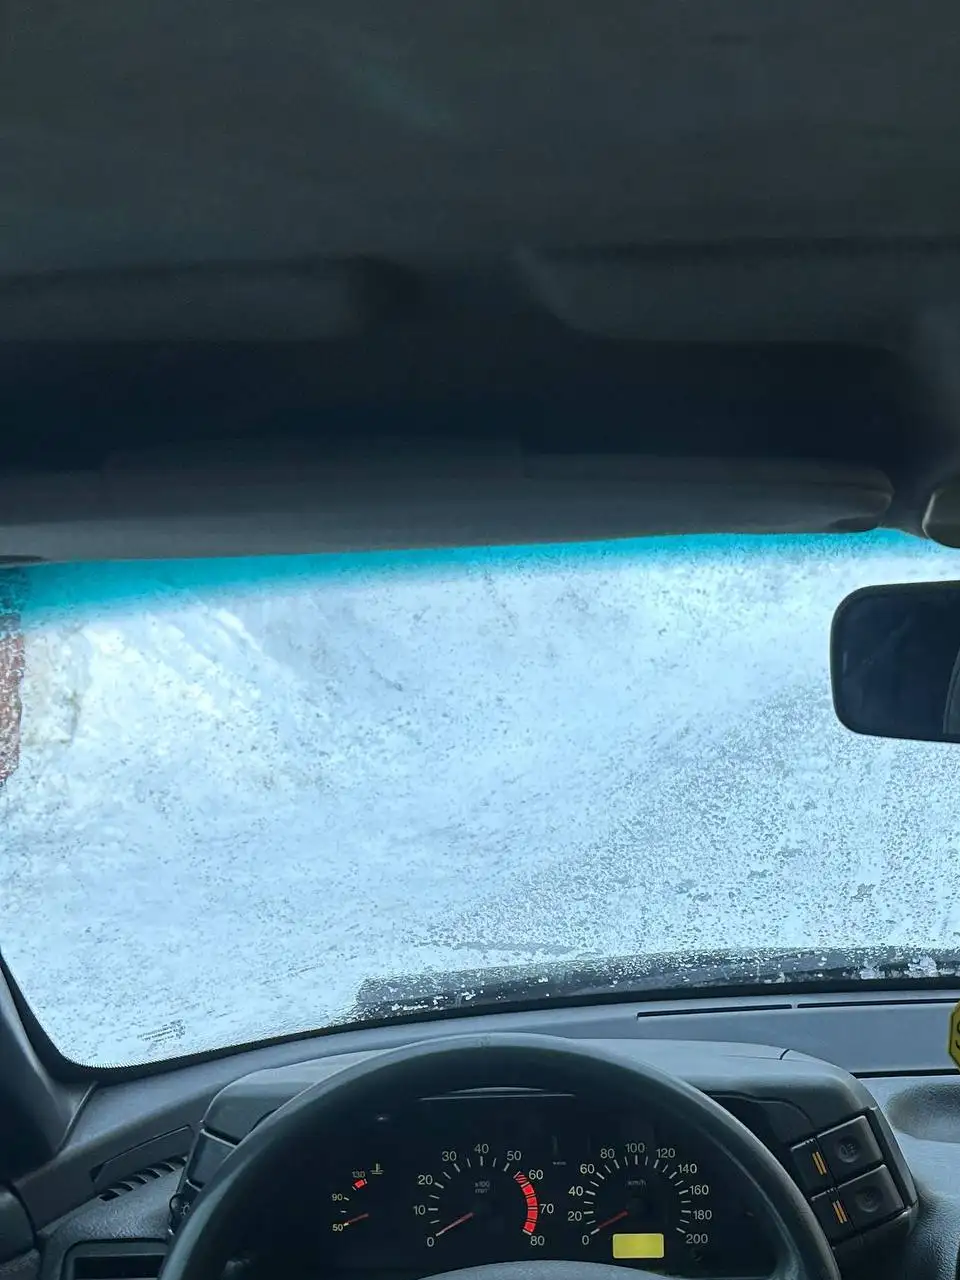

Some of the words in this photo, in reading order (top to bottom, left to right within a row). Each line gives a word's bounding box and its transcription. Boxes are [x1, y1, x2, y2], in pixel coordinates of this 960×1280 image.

[474, 1143, 490, 1154] 40
[600, 1148, 615, 1158] 80
[625, 1142, 645, 1153] 100
[656, 1148, 676, 1158] 120
[441, 1150, 457, 1162] 30
[506, 1150, 522, 1161] 50
[580, 1163, 595, 1174] 60
[677, 1163, 697, 1174] 140
[351, 1170, 366, 1179] 130
[417, 1174, 433, 1185] 20
[528, 1169, 544, 1180] 60
[568, 1186, 584, 1196] 40
[689, 1185, 709, 1195] 160
[331, 1193, 343, 1202] 90
[413, 1204, 426, 1215] 10
[540, 1203, 554, 1214] 70
[567, 1210, 582, 1221] 20
[693, 1209, 712, 1220] 180
[332, 1224, 344, 1232] 50
[426, 1236, 435, 1247] 0
[530, 1235, 545, 1246] 80
[582, 1234, 590, 1245] 0
[686, 1233, 708, 1244] 200
